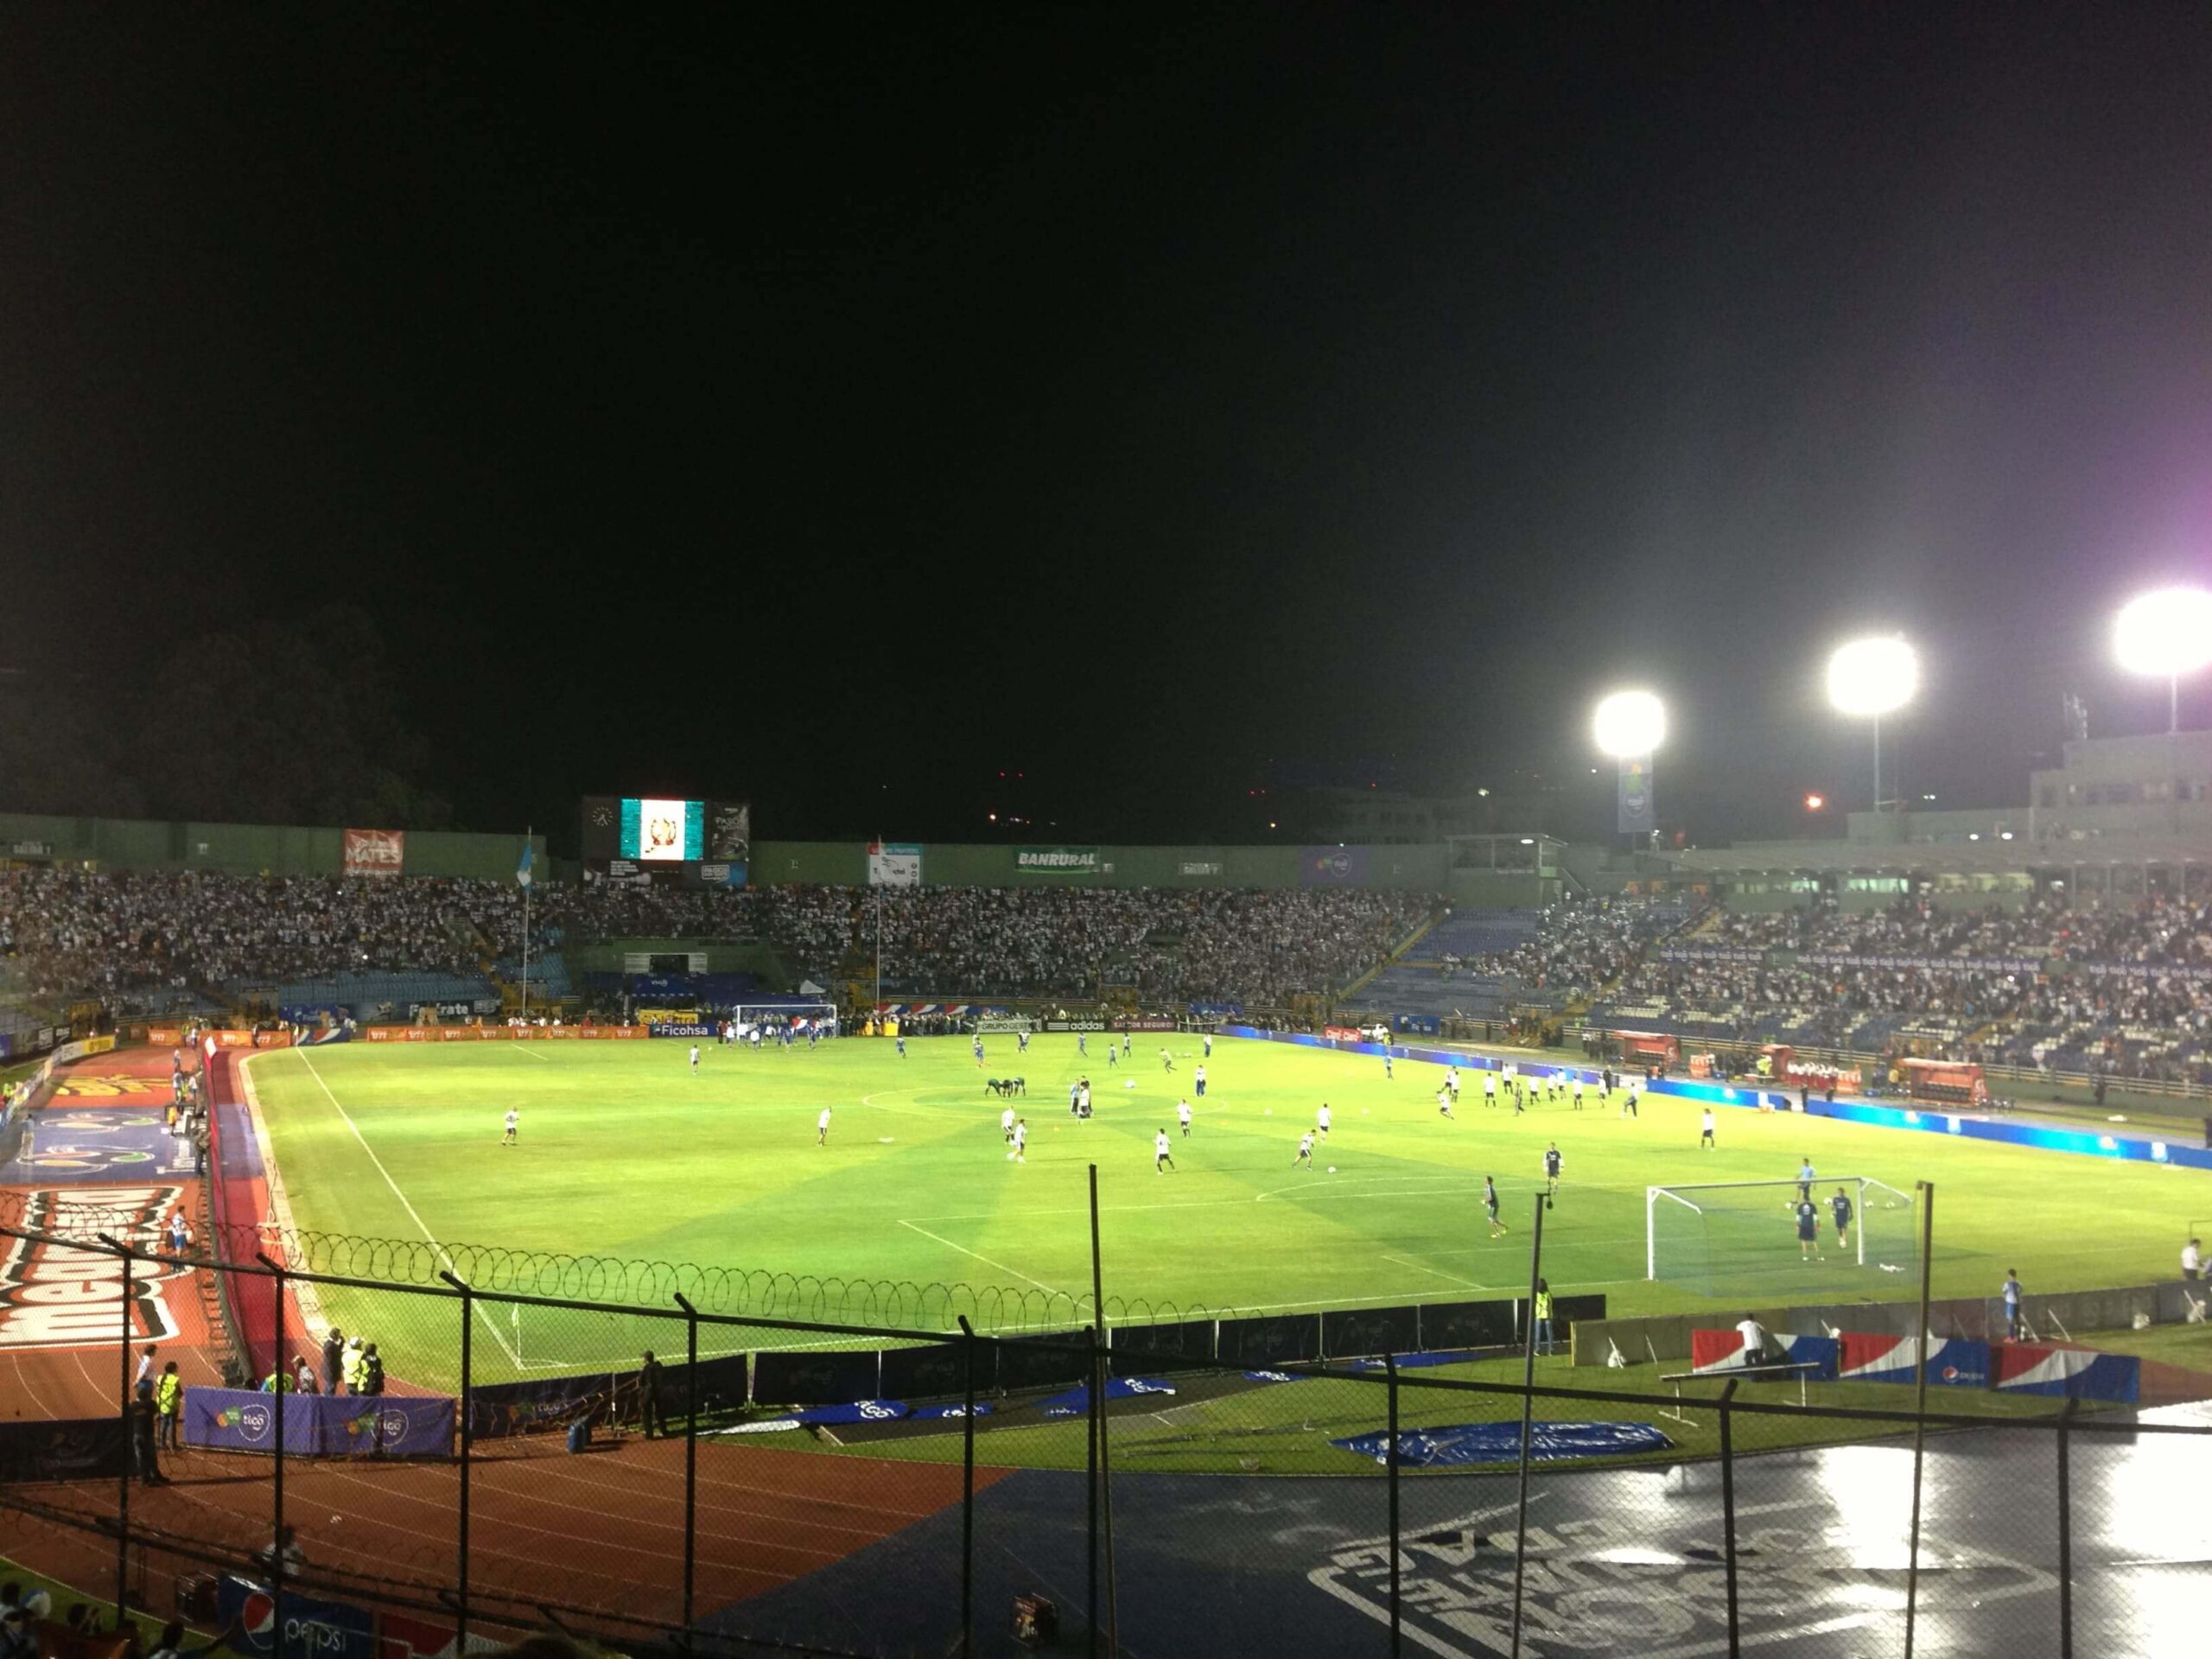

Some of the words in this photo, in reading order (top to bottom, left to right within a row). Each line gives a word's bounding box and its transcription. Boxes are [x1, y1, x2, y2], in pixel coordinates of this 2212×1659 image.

[1019, 853, 1095, 865] BANRURAL
[662, 1025, 709, 1035] Ficohsa
[1070, 1021, 1105, 1031] adidas
[243, 1414, 264, 1431] tigo
[285, 1618, 346, 1651] pepsi
